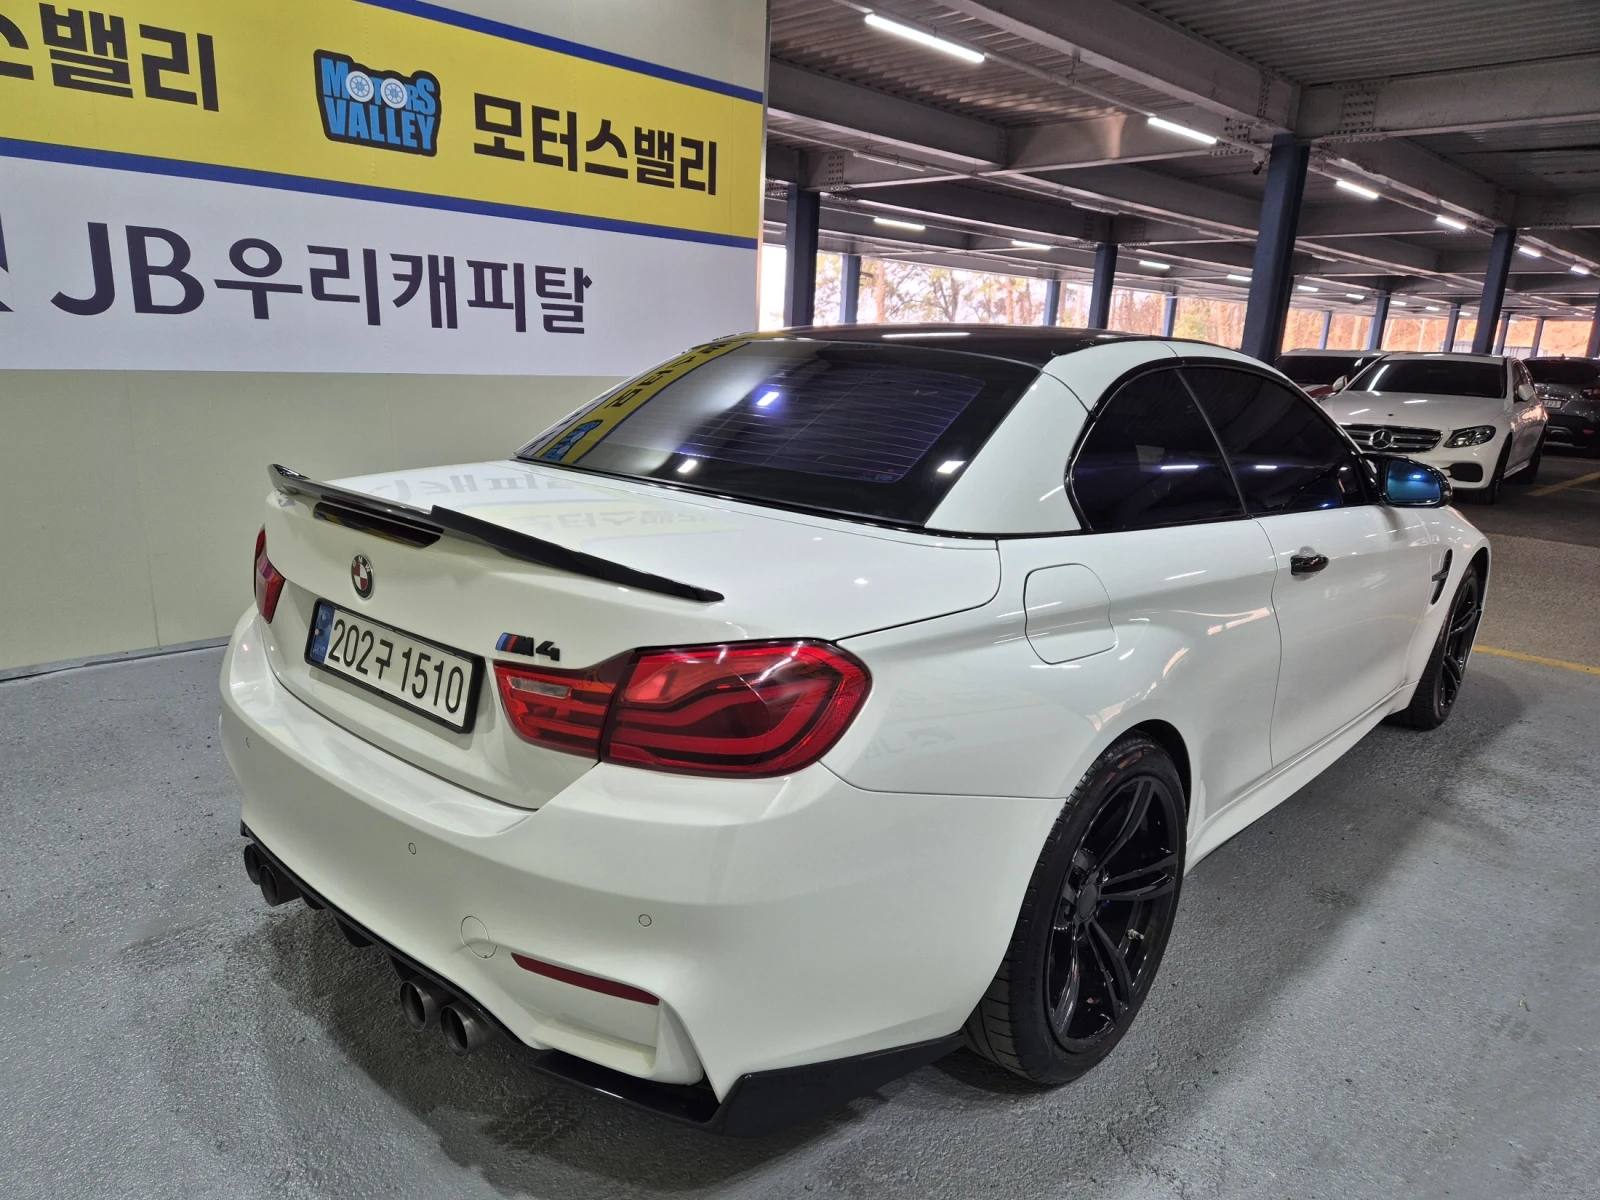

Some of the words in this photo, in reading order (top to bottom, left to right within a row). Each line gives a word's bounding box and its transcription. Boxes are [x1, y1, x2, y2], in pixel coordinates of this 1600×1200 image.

[320, 57, 436, 116] MOTORS
[323, 96, 435, 150] VALLEY
[473, 92, 717, 196] 모터스밸리
[495, 632, 561, 662] M4
